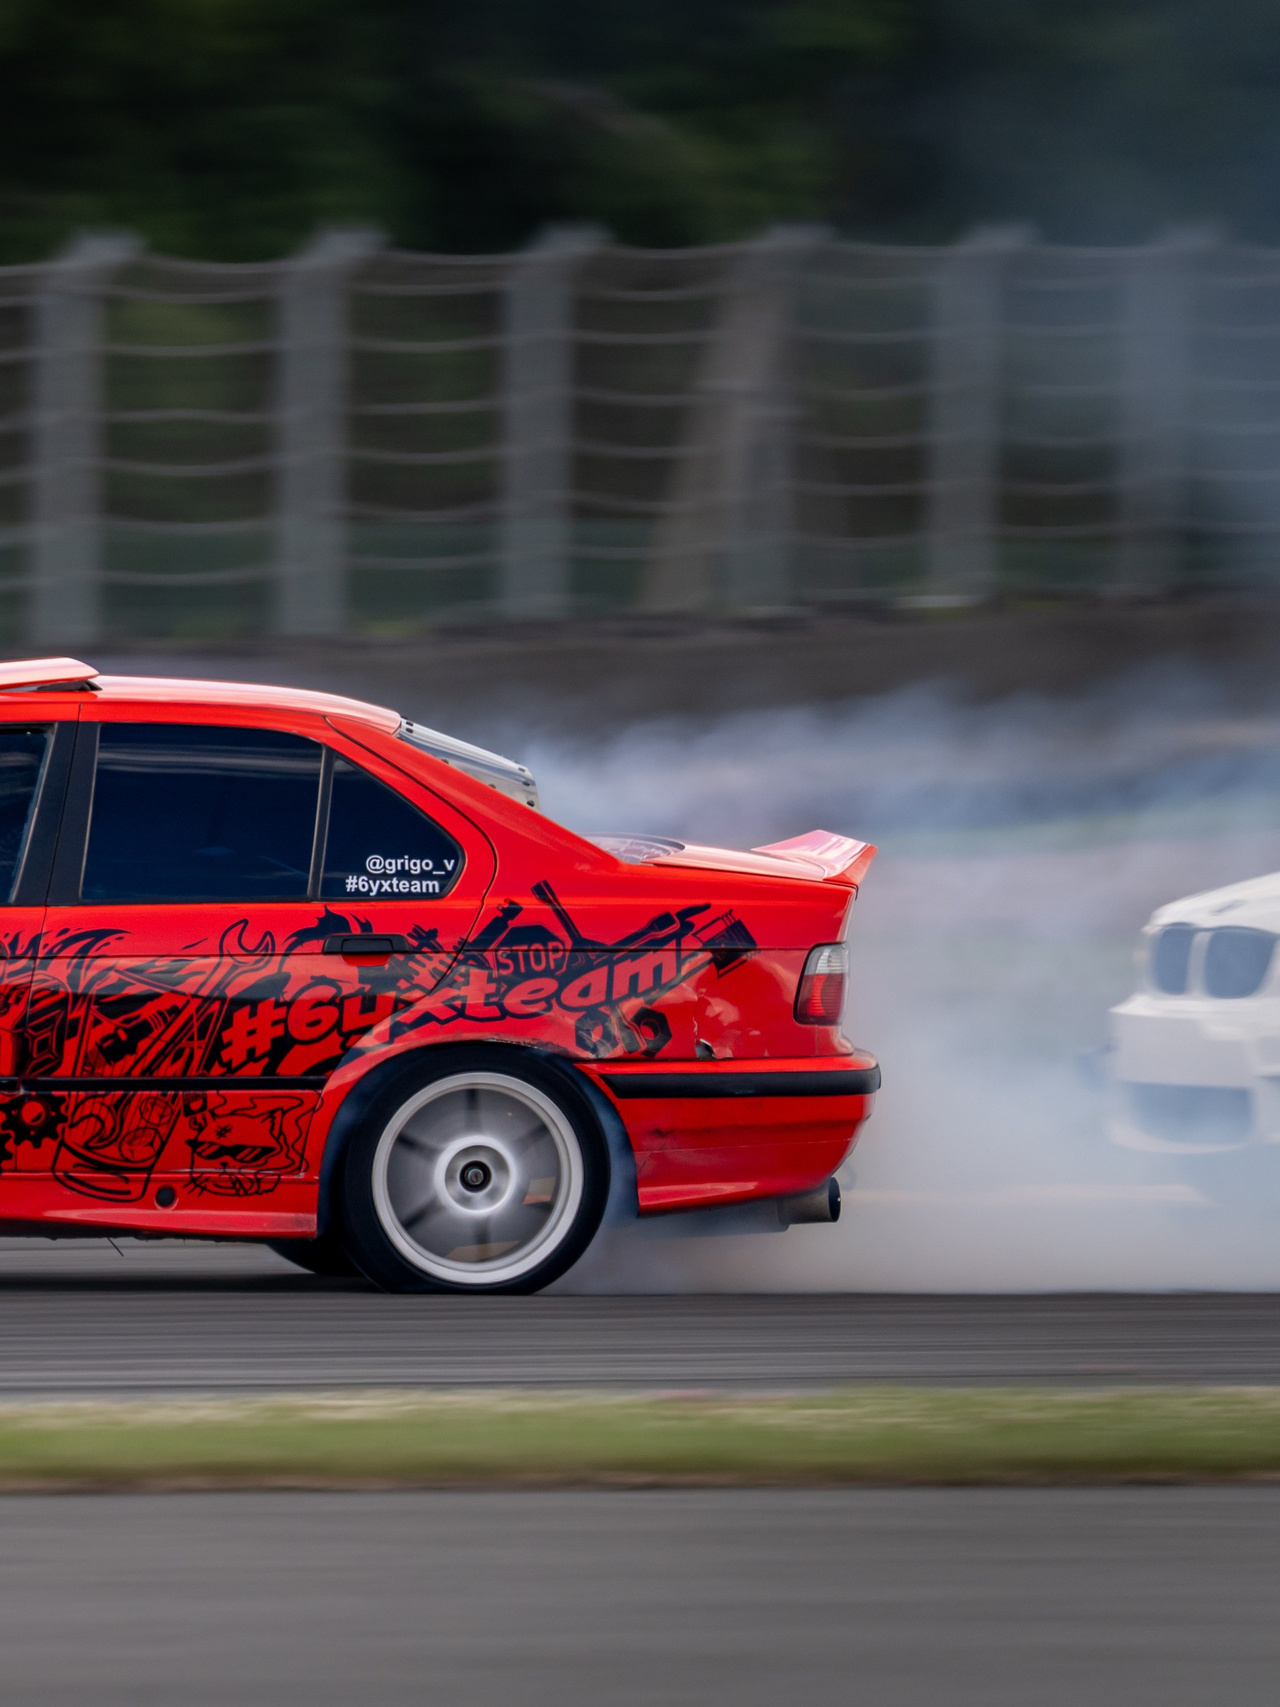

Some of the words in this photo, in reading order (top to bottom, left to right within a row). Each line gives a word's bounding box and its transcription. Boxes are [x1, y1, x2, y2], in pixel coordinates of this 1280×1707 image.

[365, 854, 455, 875] @grigo_v
[345, 875, 440, 896] #6yxteam
[497, 941, 565, 975] STOP
[220, 937, 678, 1068] #6yxteam
